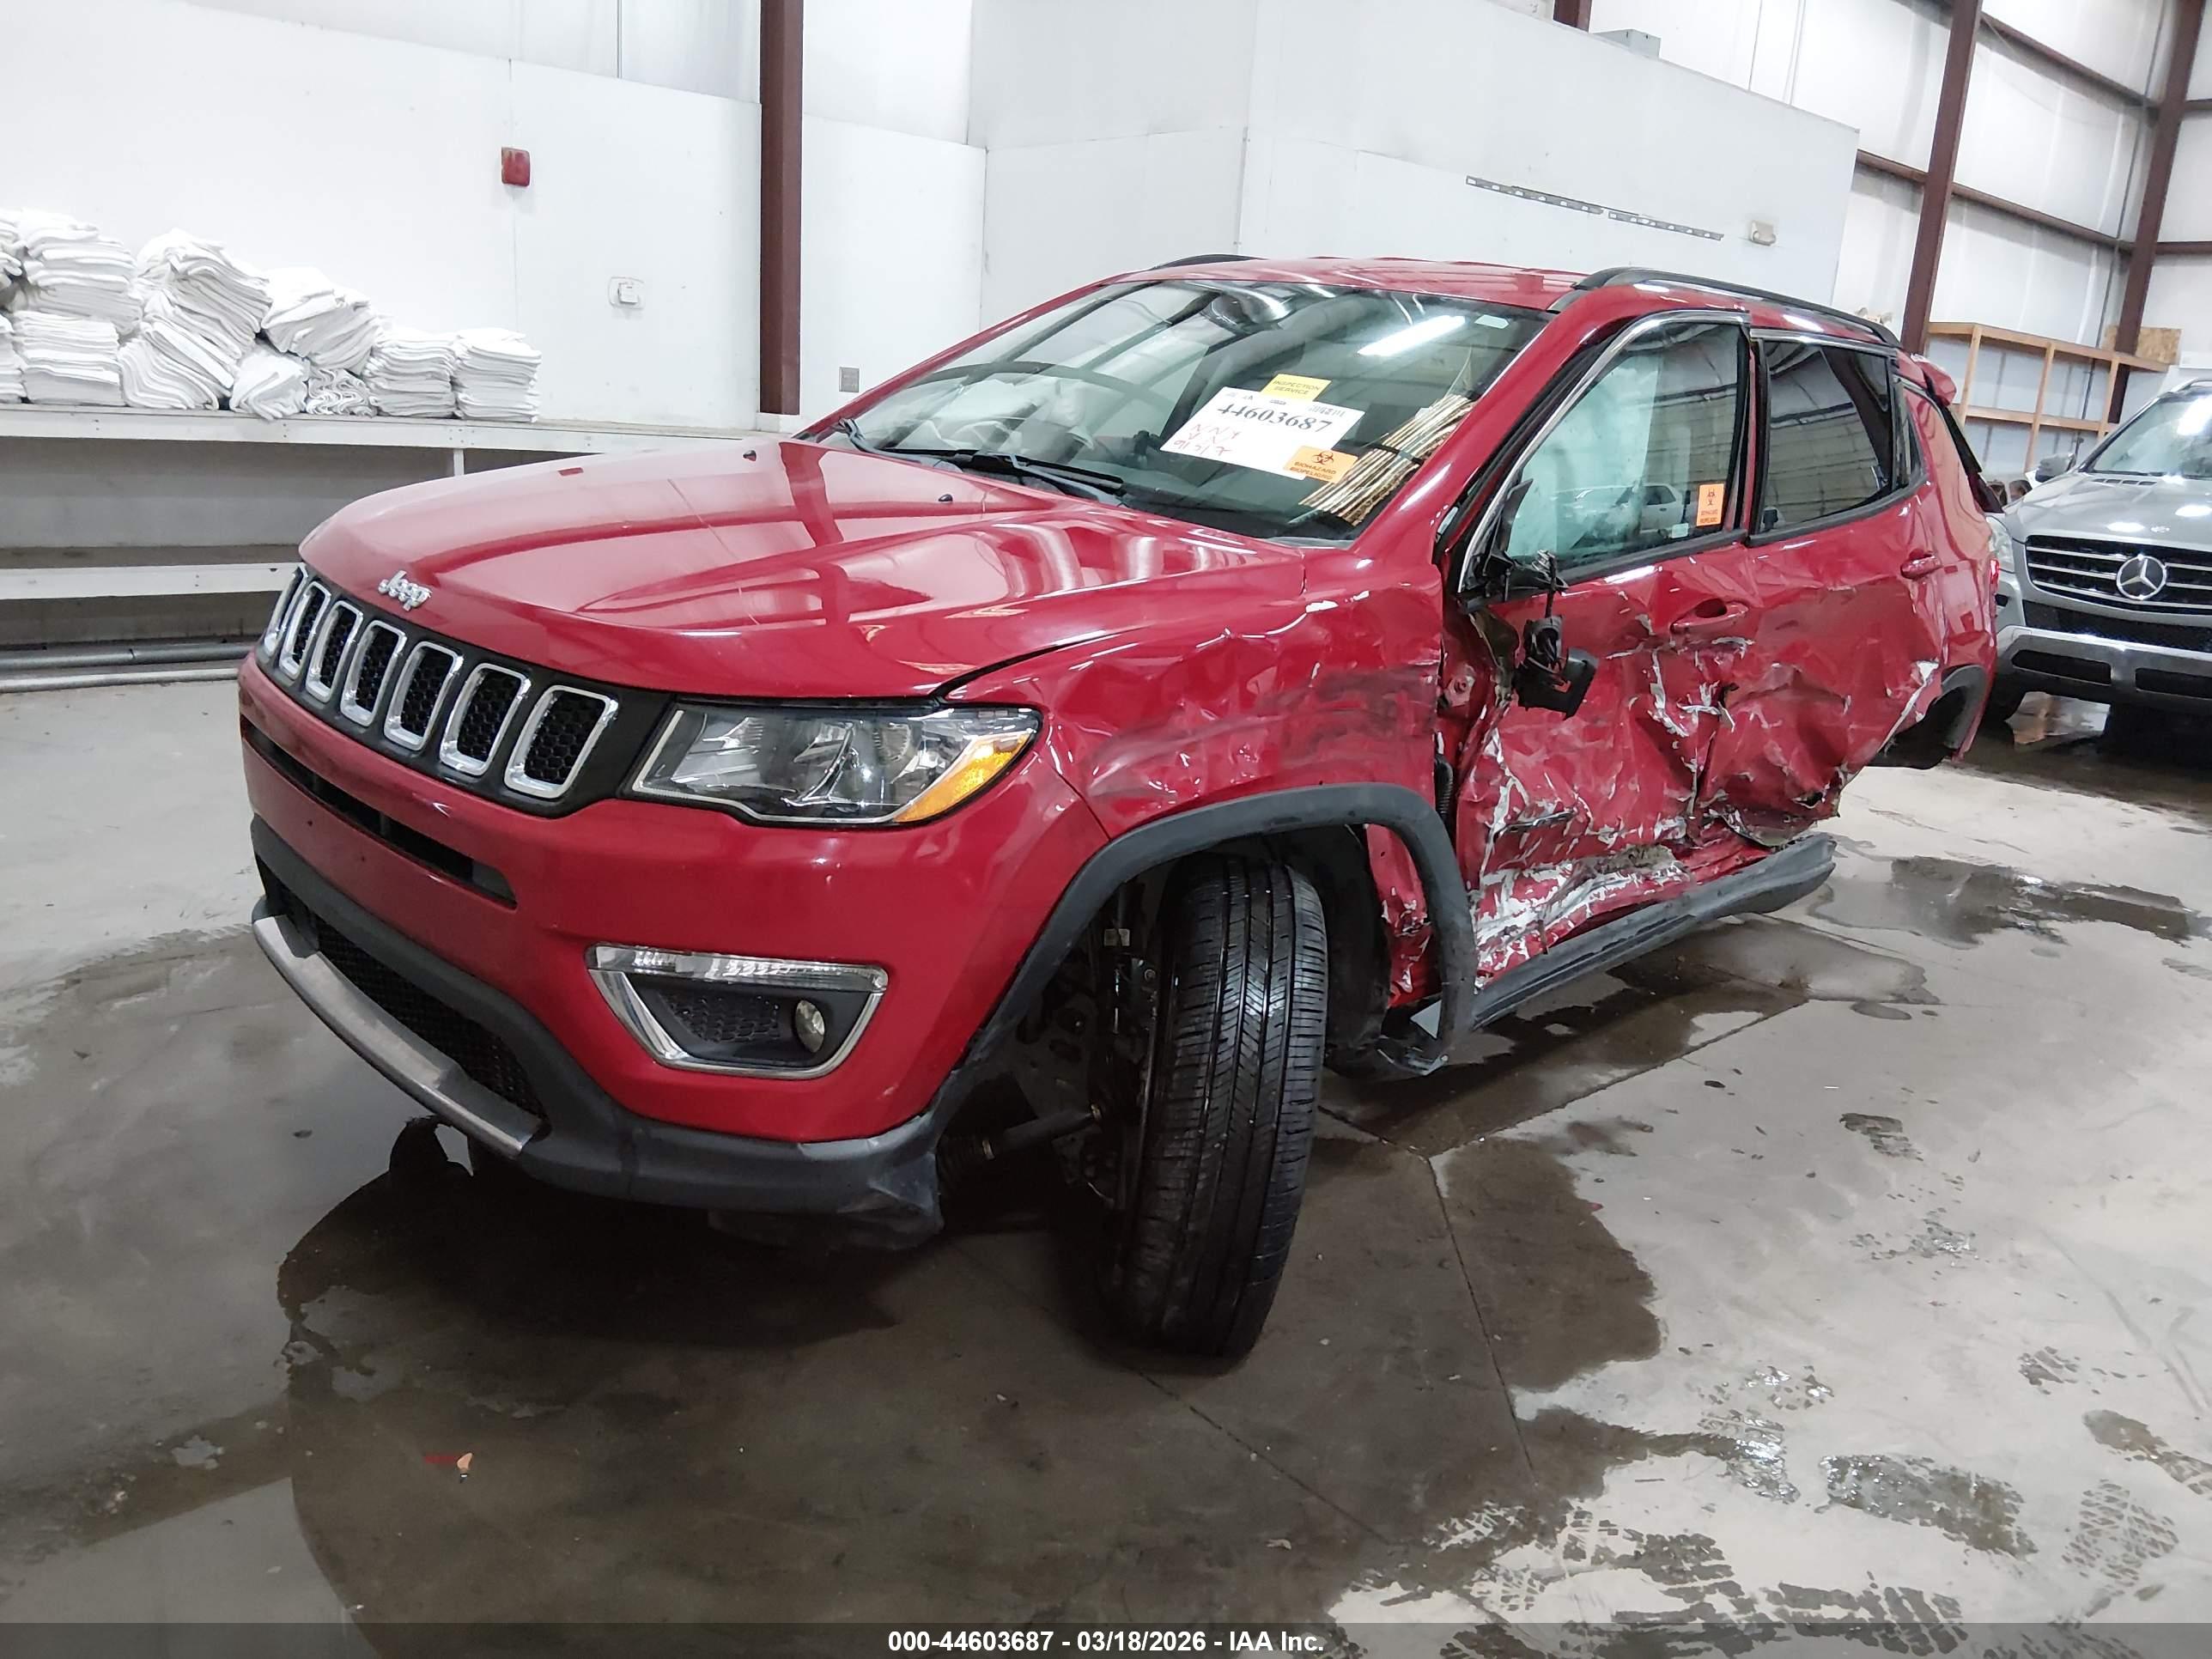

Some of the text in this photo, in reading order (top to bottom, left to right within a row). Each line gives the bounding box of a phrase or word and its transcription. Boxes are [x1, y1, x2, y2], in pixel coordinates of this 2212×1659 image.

[1273, 380, 1320, 390] INSPECTION
[1217, 404, 1333, 432] 44603687
[1294, 462, 1336, 474] BIOHAZARD
[379, 570, 433, 611] Jeep
